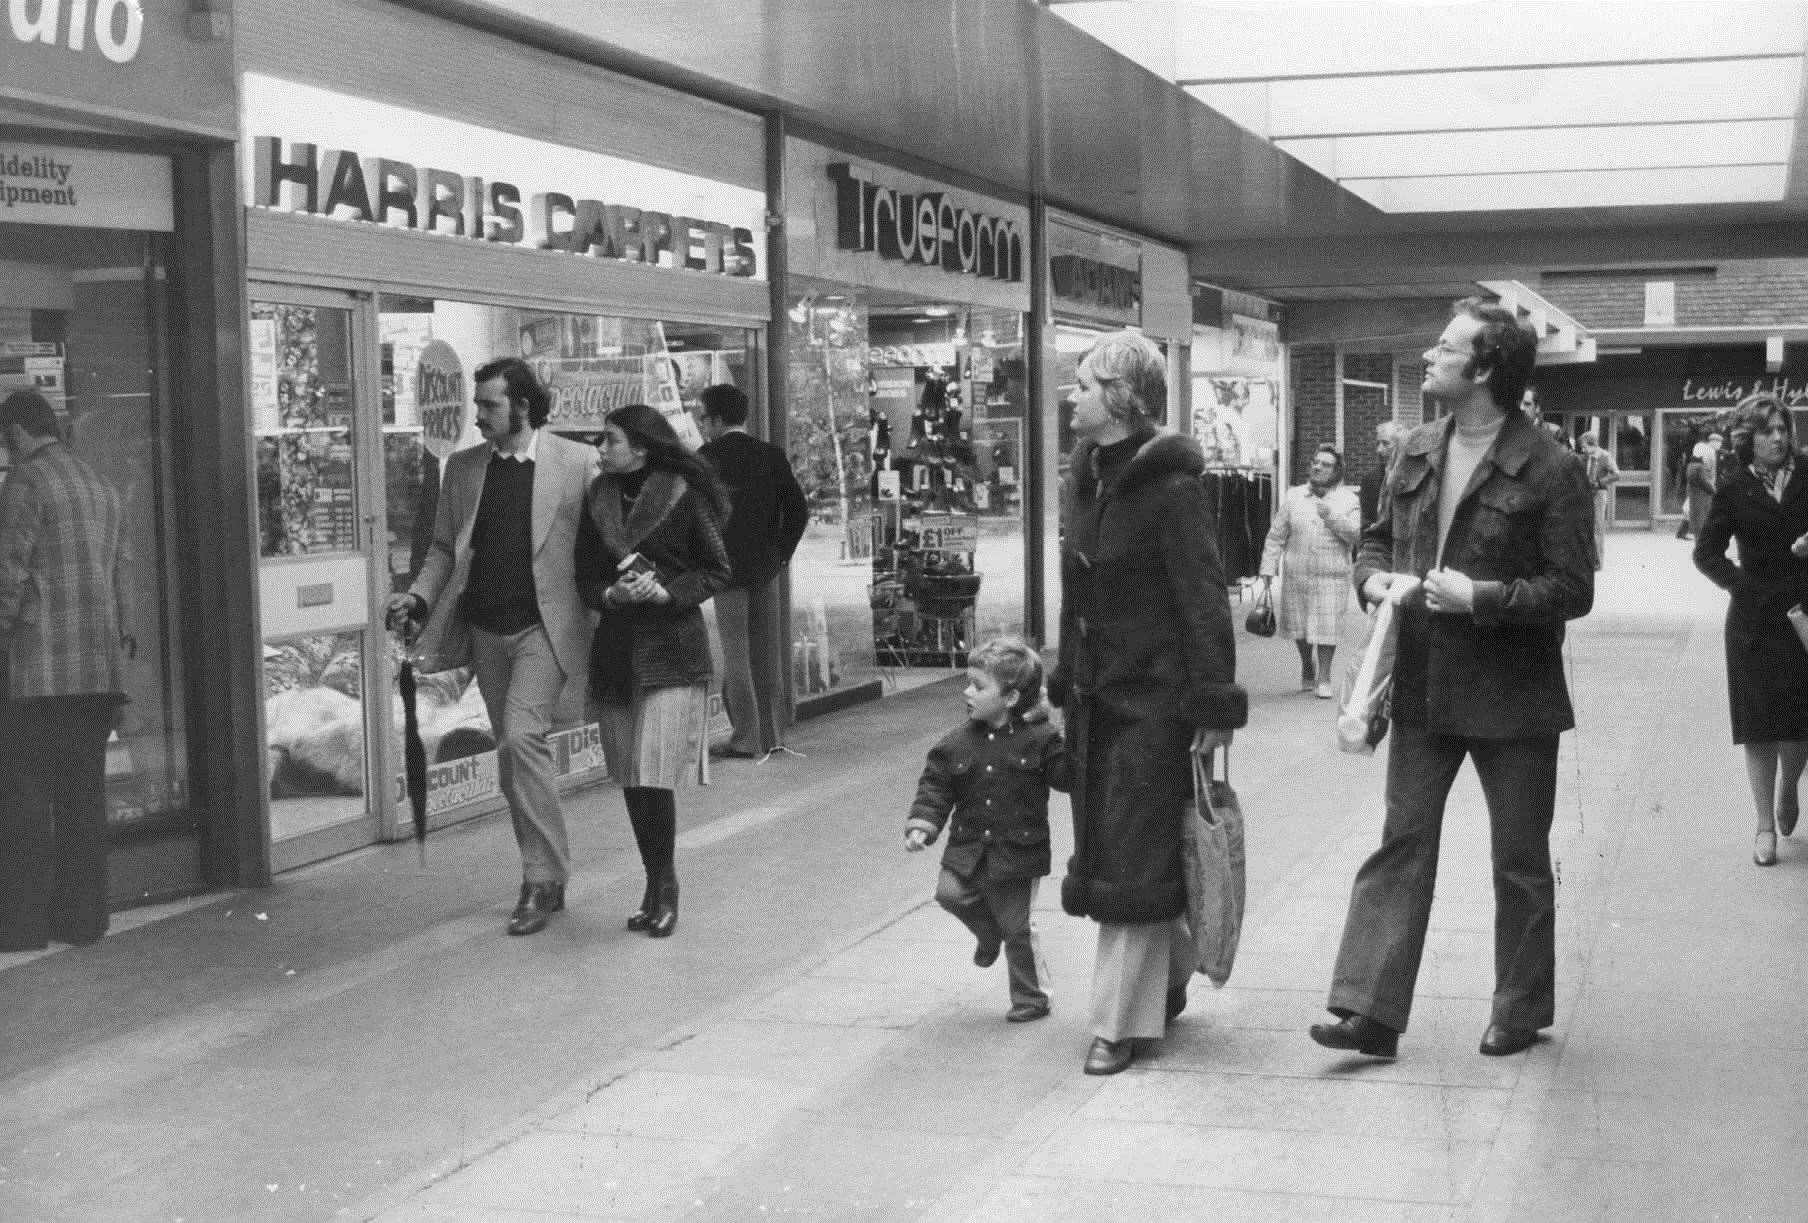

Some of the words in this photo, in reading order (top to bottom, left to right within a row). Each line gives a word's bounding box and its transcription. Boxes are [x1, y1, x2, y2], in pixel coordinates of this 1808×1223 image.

[254, 136, 524, 244] HARRIS
[530, 192, 757, 277] CARPETS
[1683, 379, 1742, 400] Lewis
